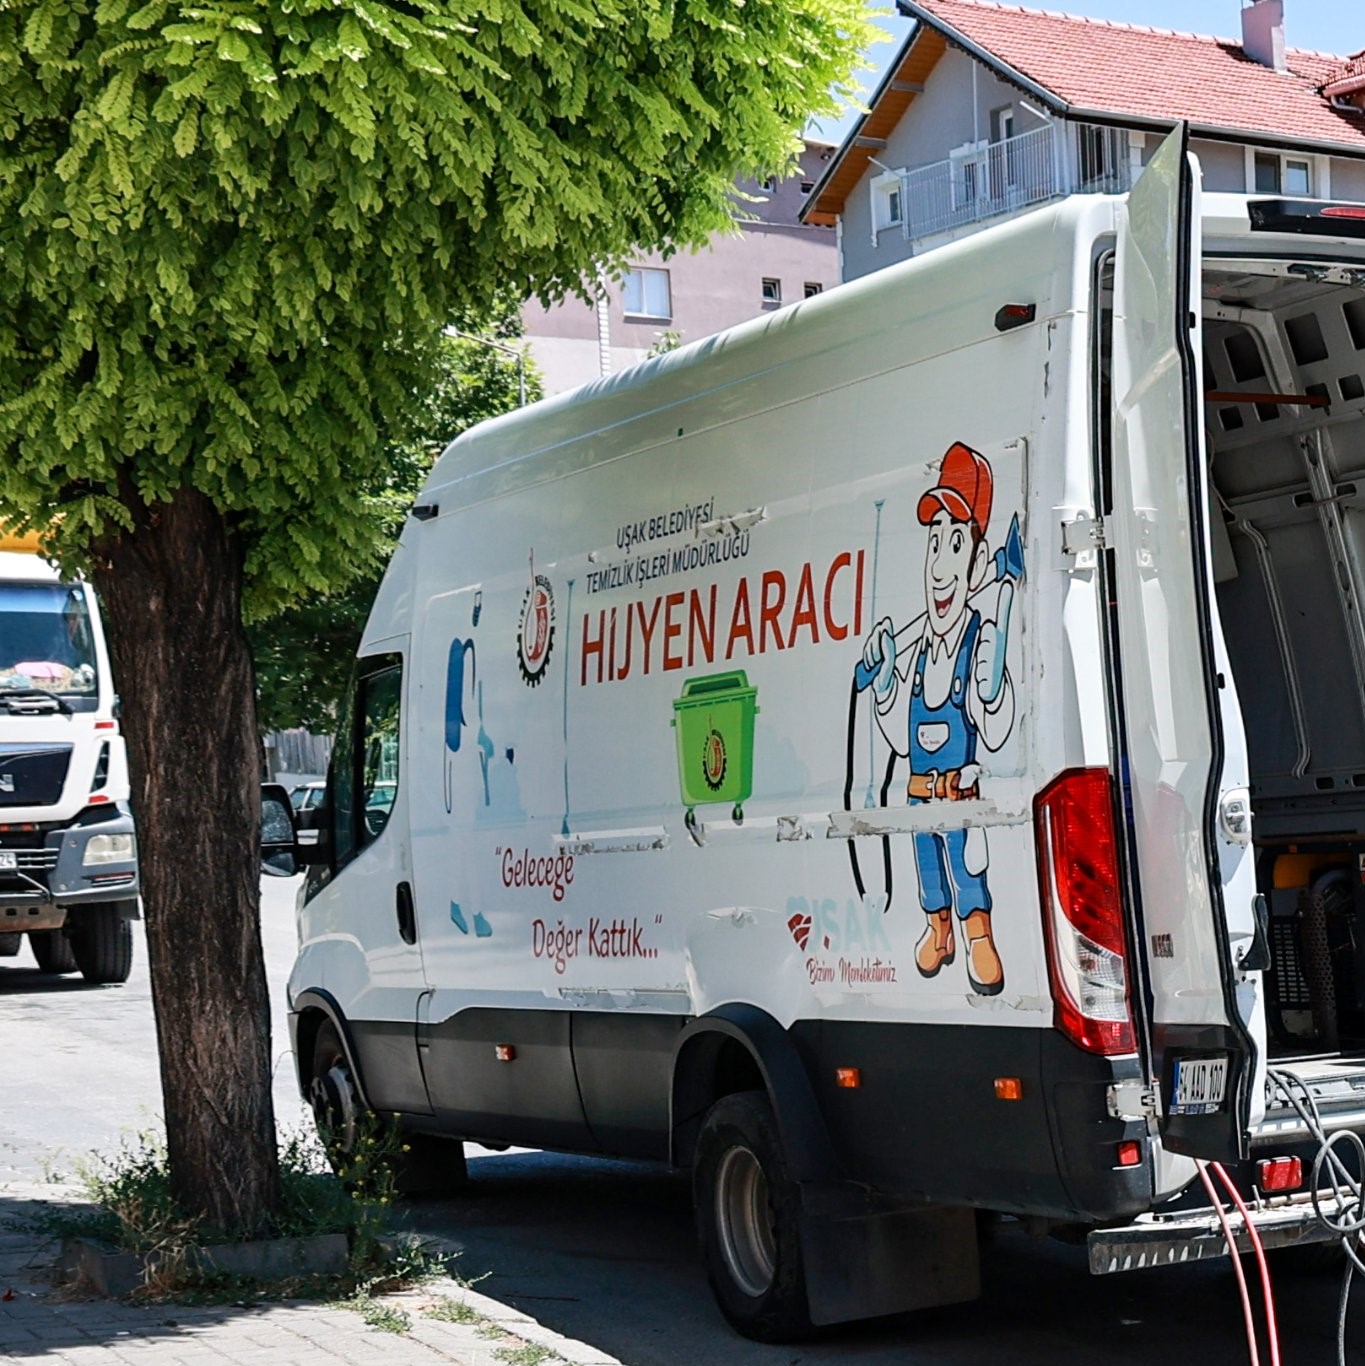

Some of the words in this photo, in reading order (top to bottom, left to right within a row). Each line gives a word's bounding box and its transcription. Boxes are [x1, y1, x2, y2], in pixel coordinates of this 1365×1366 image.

[616, 520, 647, 554] UŞAK
[649, 496, 715, 541] BELEDİYESİ
[586, 558, 635, 595] TEMİZLİK
[635, 549, 671, 589] İŞLERİ
[672, 529, 751, 574] MÜDÜRLÜĞÜ
[725, 549, 865, 661] ARACI
[532, 918, 583, 975] Değer
